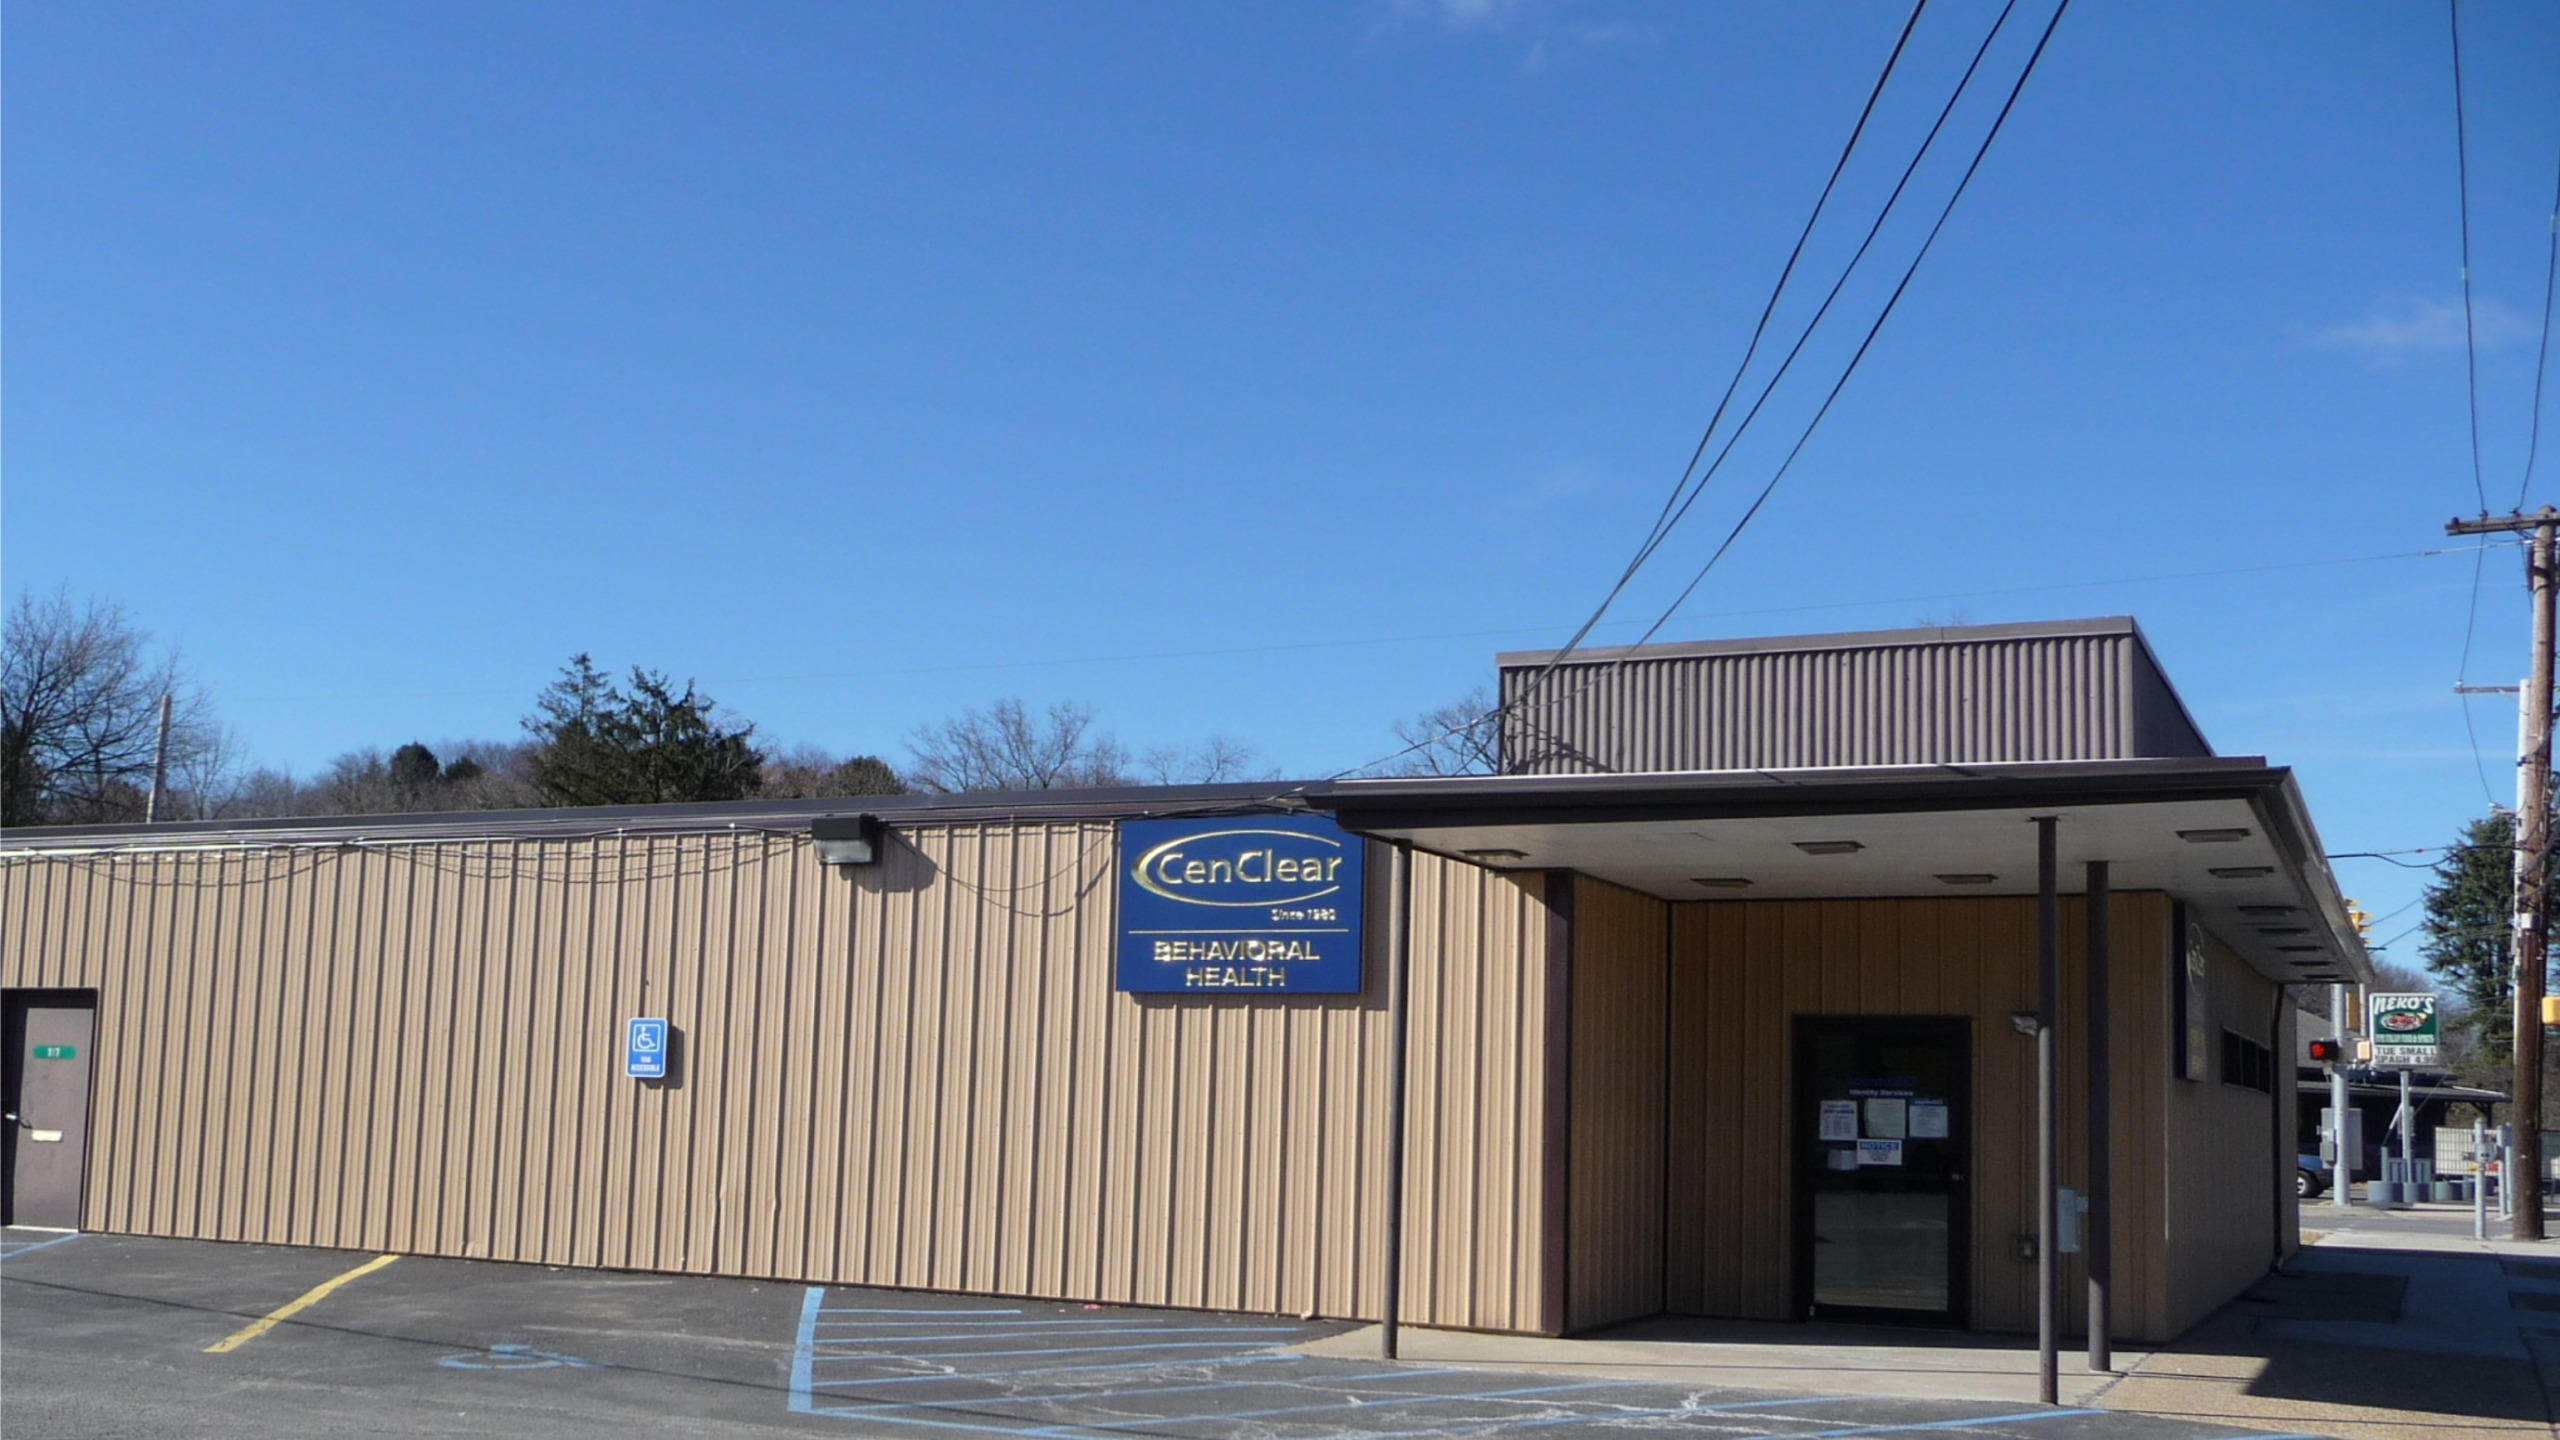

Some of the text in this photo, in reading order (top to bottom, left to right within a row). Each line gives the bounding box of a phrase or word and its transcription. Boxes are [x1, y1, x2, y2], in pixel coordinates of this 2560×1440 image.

[1157, 849, 1342, 885] CenClear
[1271, 908, 1305, 921] Since
[1154, 940, 1320, 962] BEHAVIORAL
[1185, 967, 1286, 987] HEALTH
[2374, 996, 2434, 1015] NEKO'S
[2376, 1047, 2436, 1055] TUE SMALL
[1861, 1142, 1897, 1150] NOTICE
